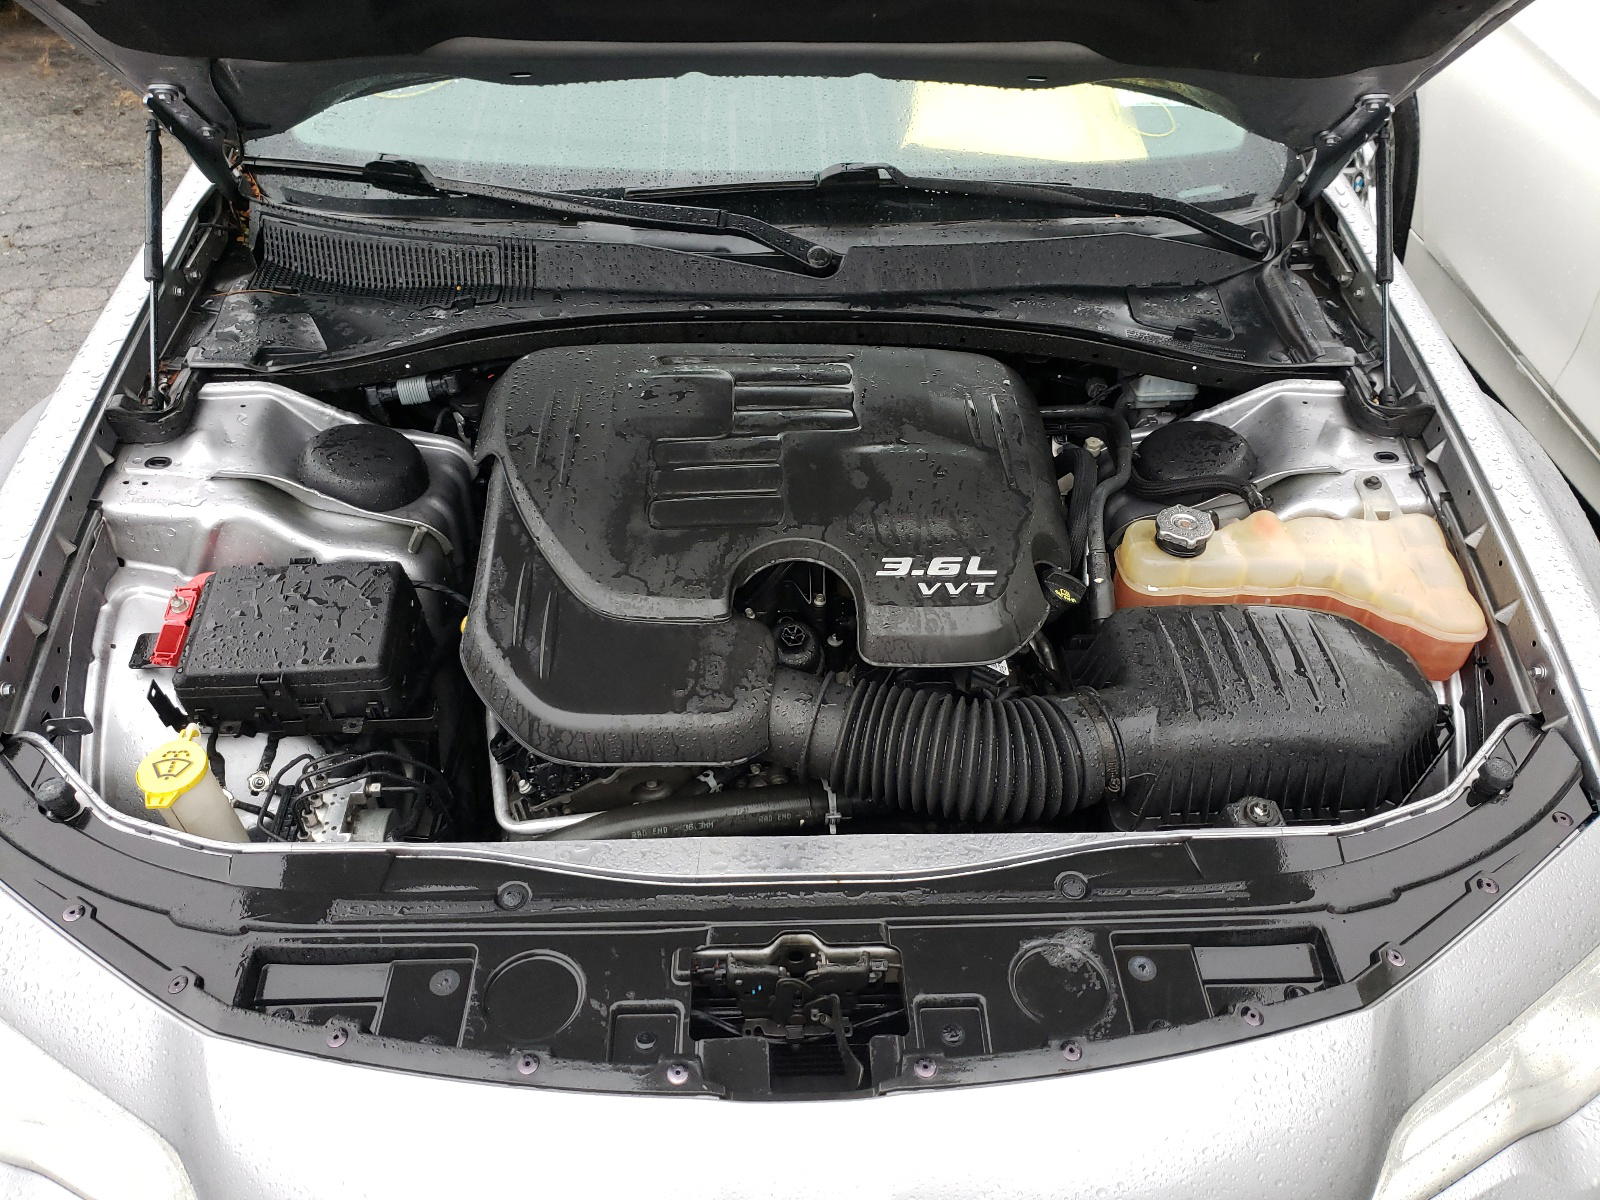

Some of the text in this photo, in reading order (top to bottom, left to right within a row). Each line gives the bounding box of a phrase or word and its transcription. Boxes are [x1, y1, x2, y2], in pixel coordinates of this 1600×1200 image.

[876, 556, 997, 576] 3.6L
[918, 582, 994, 597] VVT
[652, 825, 668, 835] END
